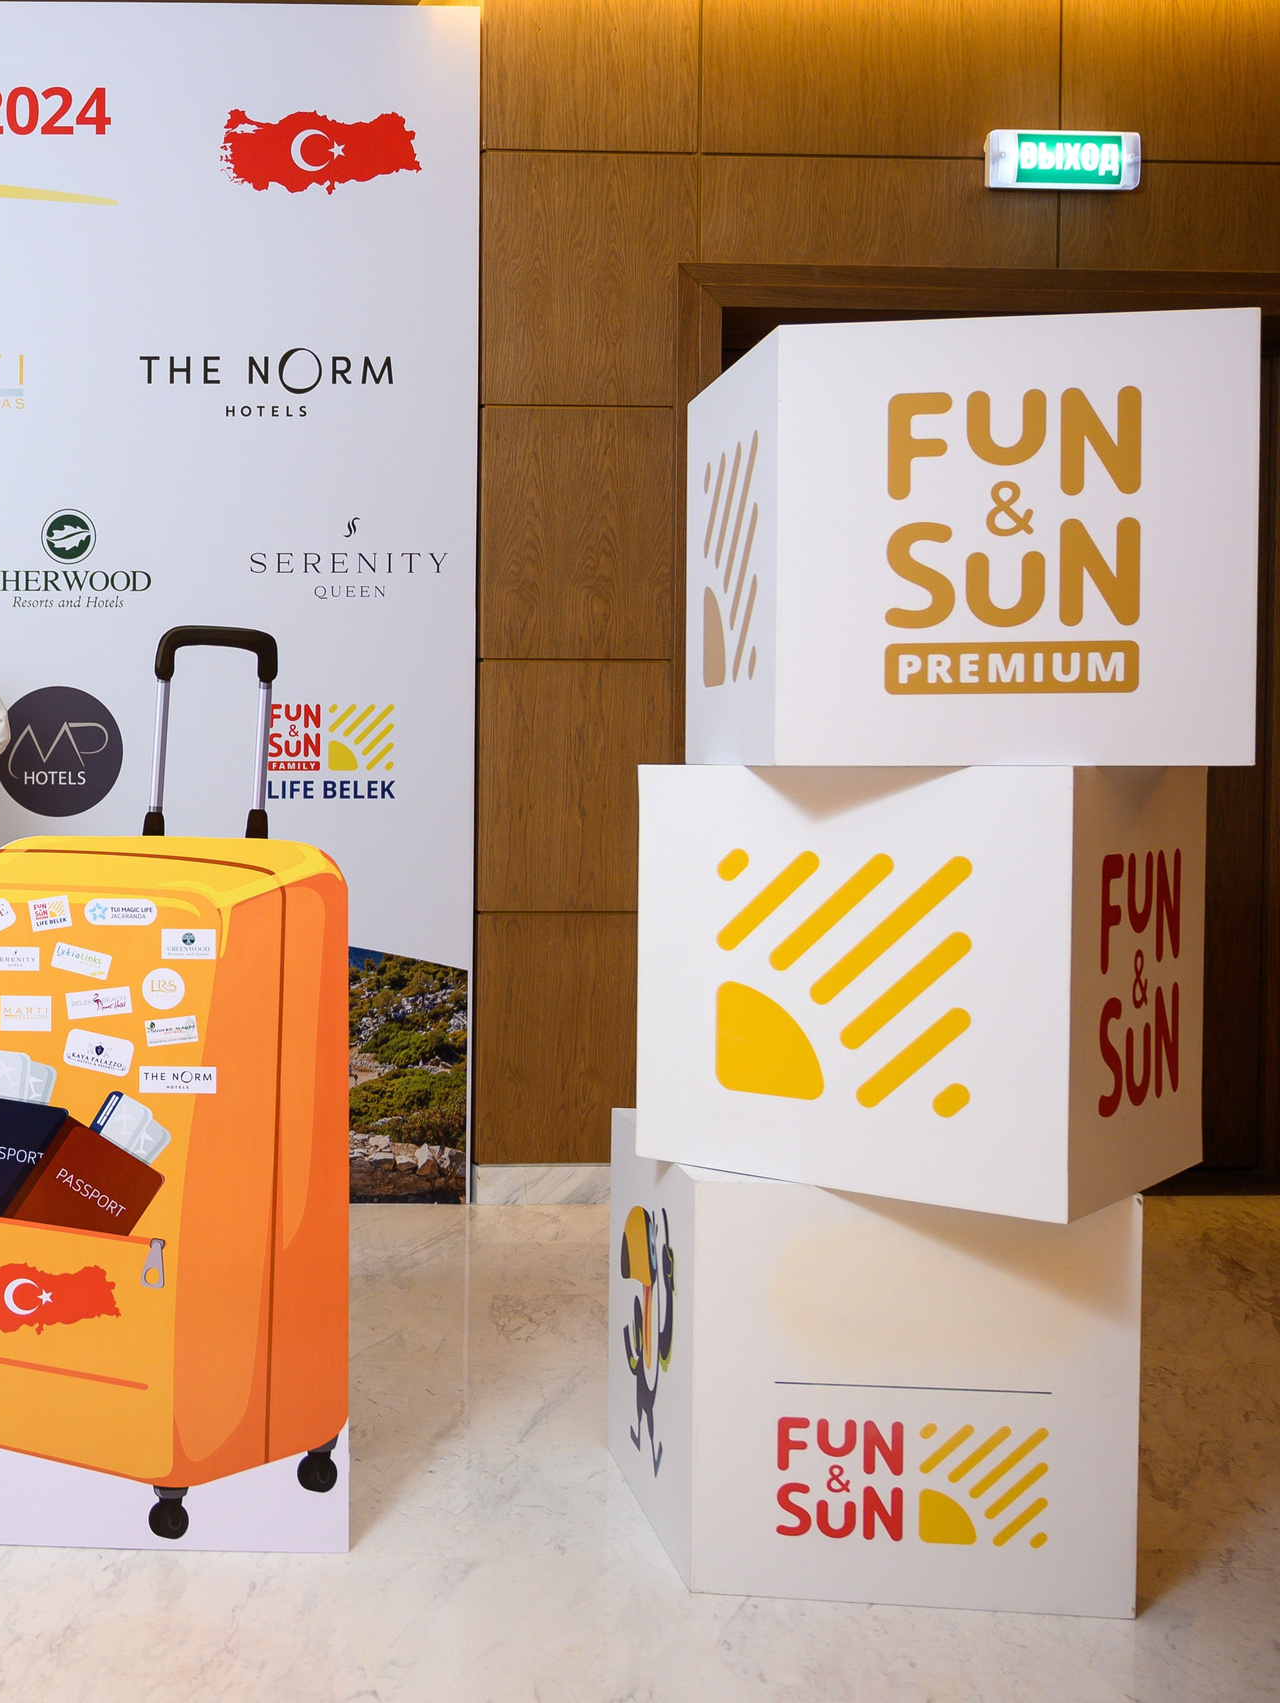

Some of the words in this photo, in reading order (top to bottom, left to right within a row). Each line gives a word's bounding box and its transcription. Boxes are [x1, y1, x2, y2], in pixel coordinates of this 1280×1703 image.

[1021, 142, 1119, 176] ВЫХОД
[140, 356, 220, 384] THE
[248, 348, 394, 394] NORM
[226, 406, 308, 417] HOTELS
[887, 385, 1142, 501] FUN
[986, 480, 1034, 536] &
[250, 552, 448, 573] SERENITY
[884, 516, 1141, 629] SUN
[12, 596, 53, 608] Resorts
[58, 596, 81, 608] and
[86, 596, 124, 608] Hotels
[314, 585, 386, 599] QUEEN
[898, 651, 1125, 684] PREMIUM
[270, 704, 321, 728] FUN
[289, 724, 299, 737] &
[8, 721, 108, 779] MP
[268, 733, 320, 757] SUN
[24, 771, 86, 785] HOTELS
[268, 780, 314, 799] LIFE
[323, 780, 395, 799] BELEK
[1101, 848, 1182, 975] FUN
[1132, 948, 1149, 1010] &
[1098, 981, 1180, 1117] SUN
[144, 1072, 166, 1080] THE
[173, 1071, 212, 1083] NORM
[56, 1168, 127, 1218] PASSPORT
[777, 1416, 904, 1476] FUN
[826, 1464, 851, 1493] &
[776, 1482, 904, 1542] SUN
